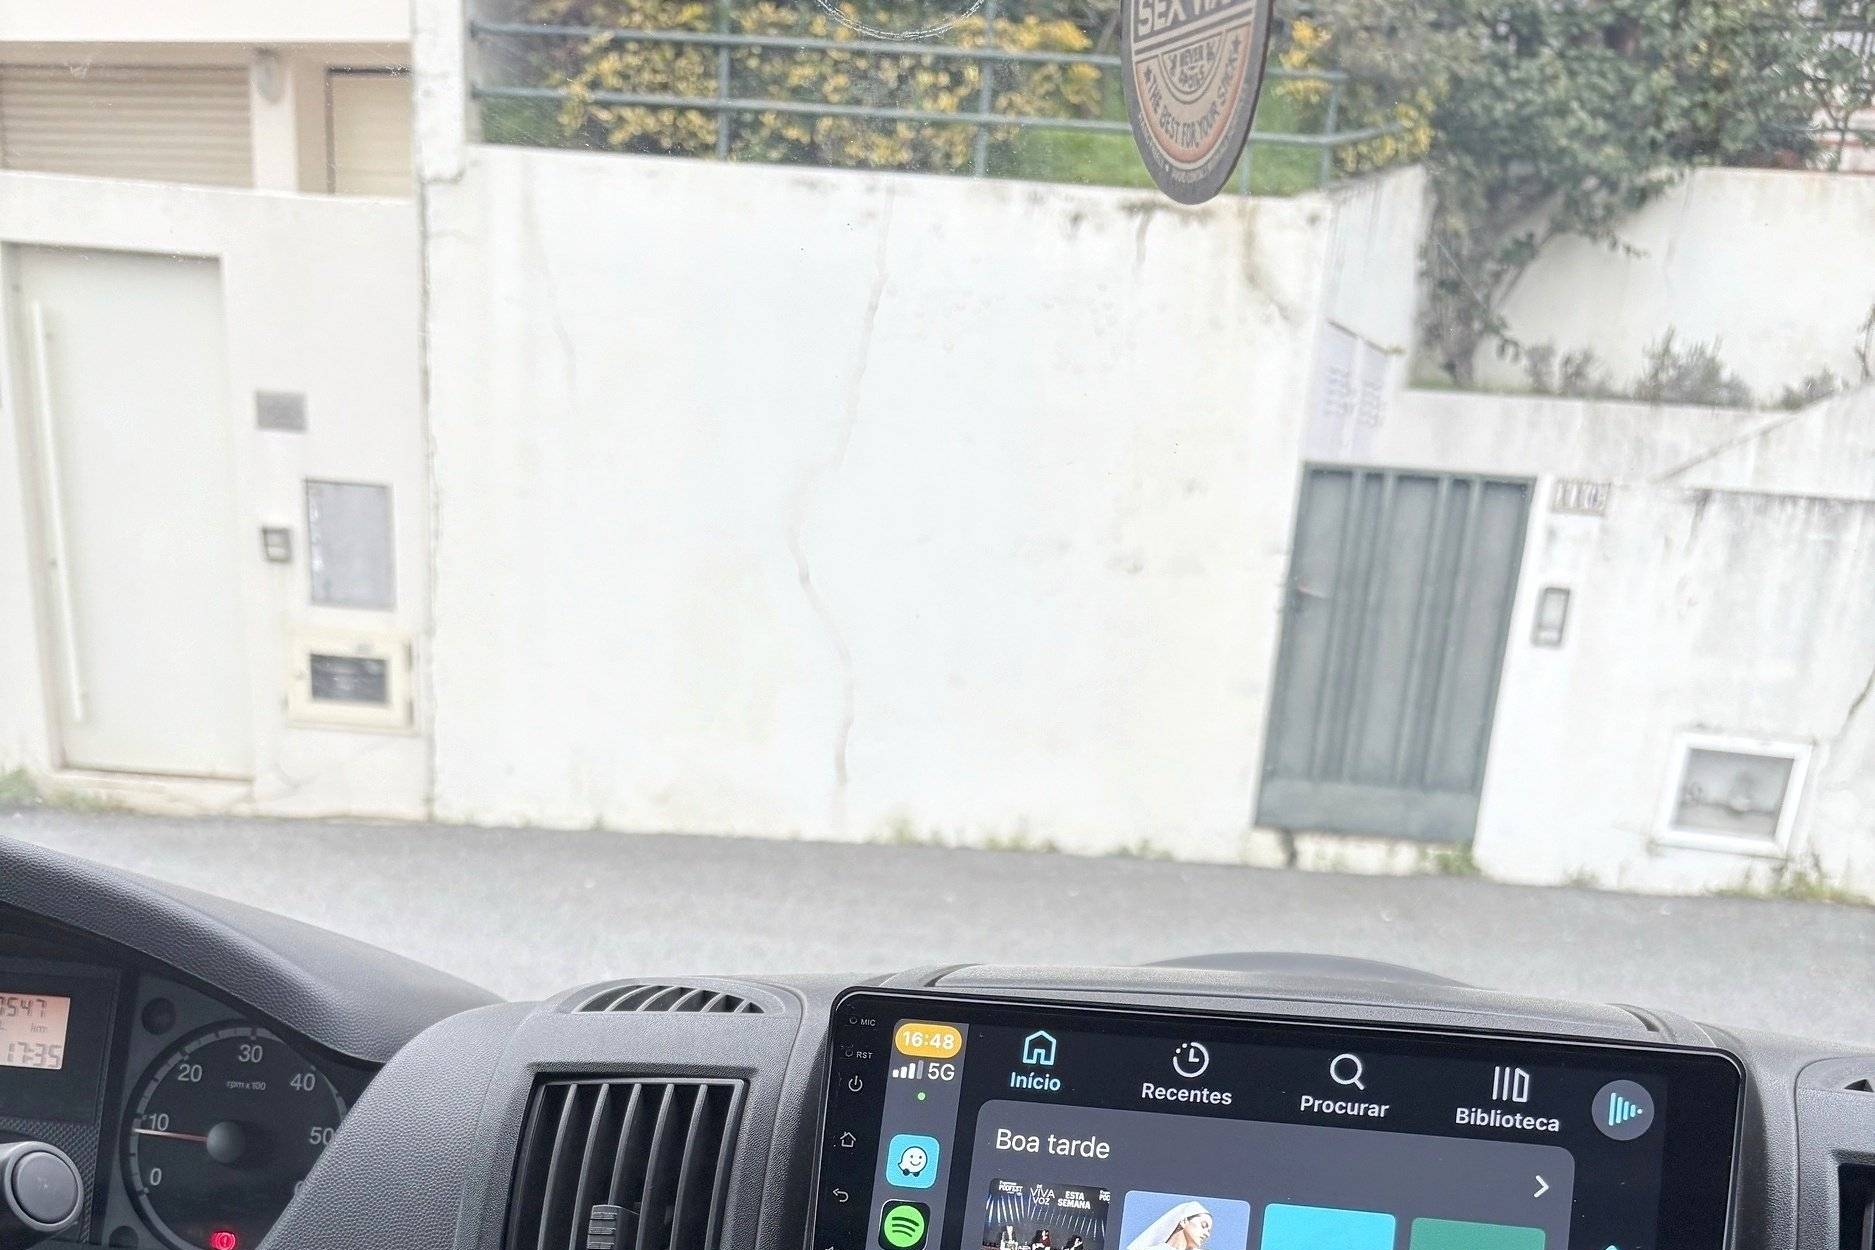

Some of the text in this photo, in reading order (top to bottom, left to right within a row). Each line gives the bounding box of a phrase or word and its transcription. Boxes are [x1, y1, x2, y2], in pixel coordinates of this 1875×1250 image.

[860, 1018, 876, 1027] MIC
[903, 1031, 955, 1049] 16:48
[7, 1041, 62, 1067] 17:35
[238, 1045, 263, 1063] 30
[856, 1051, 873, 1060] RST
[177, 1063, 203, 1083] 20
[928, 1063, 956, 1081] 5G
[290, 1072, 315, 1092] 40
[1010, 1071, 1061, 1092] Início
[1142, 1083, 1233, 1106] Recentes
[1300, 1095, 1389, 1119] Procurar
[149, 1113, 169, 1131] 10
[1455, 1107, 1560, 1132] Biblioteca
[309, 1127, 335, 1145] 50
[995, 1128, 1111, 1159] Boa tarde
[150, 1168, 162, 1186] 0
[1033, 1197, 1051, 1206] VOZ
[1057, 1198, 1091, 1210] SEMANA
[1065, 1191, 1085, 1201] ESTA
